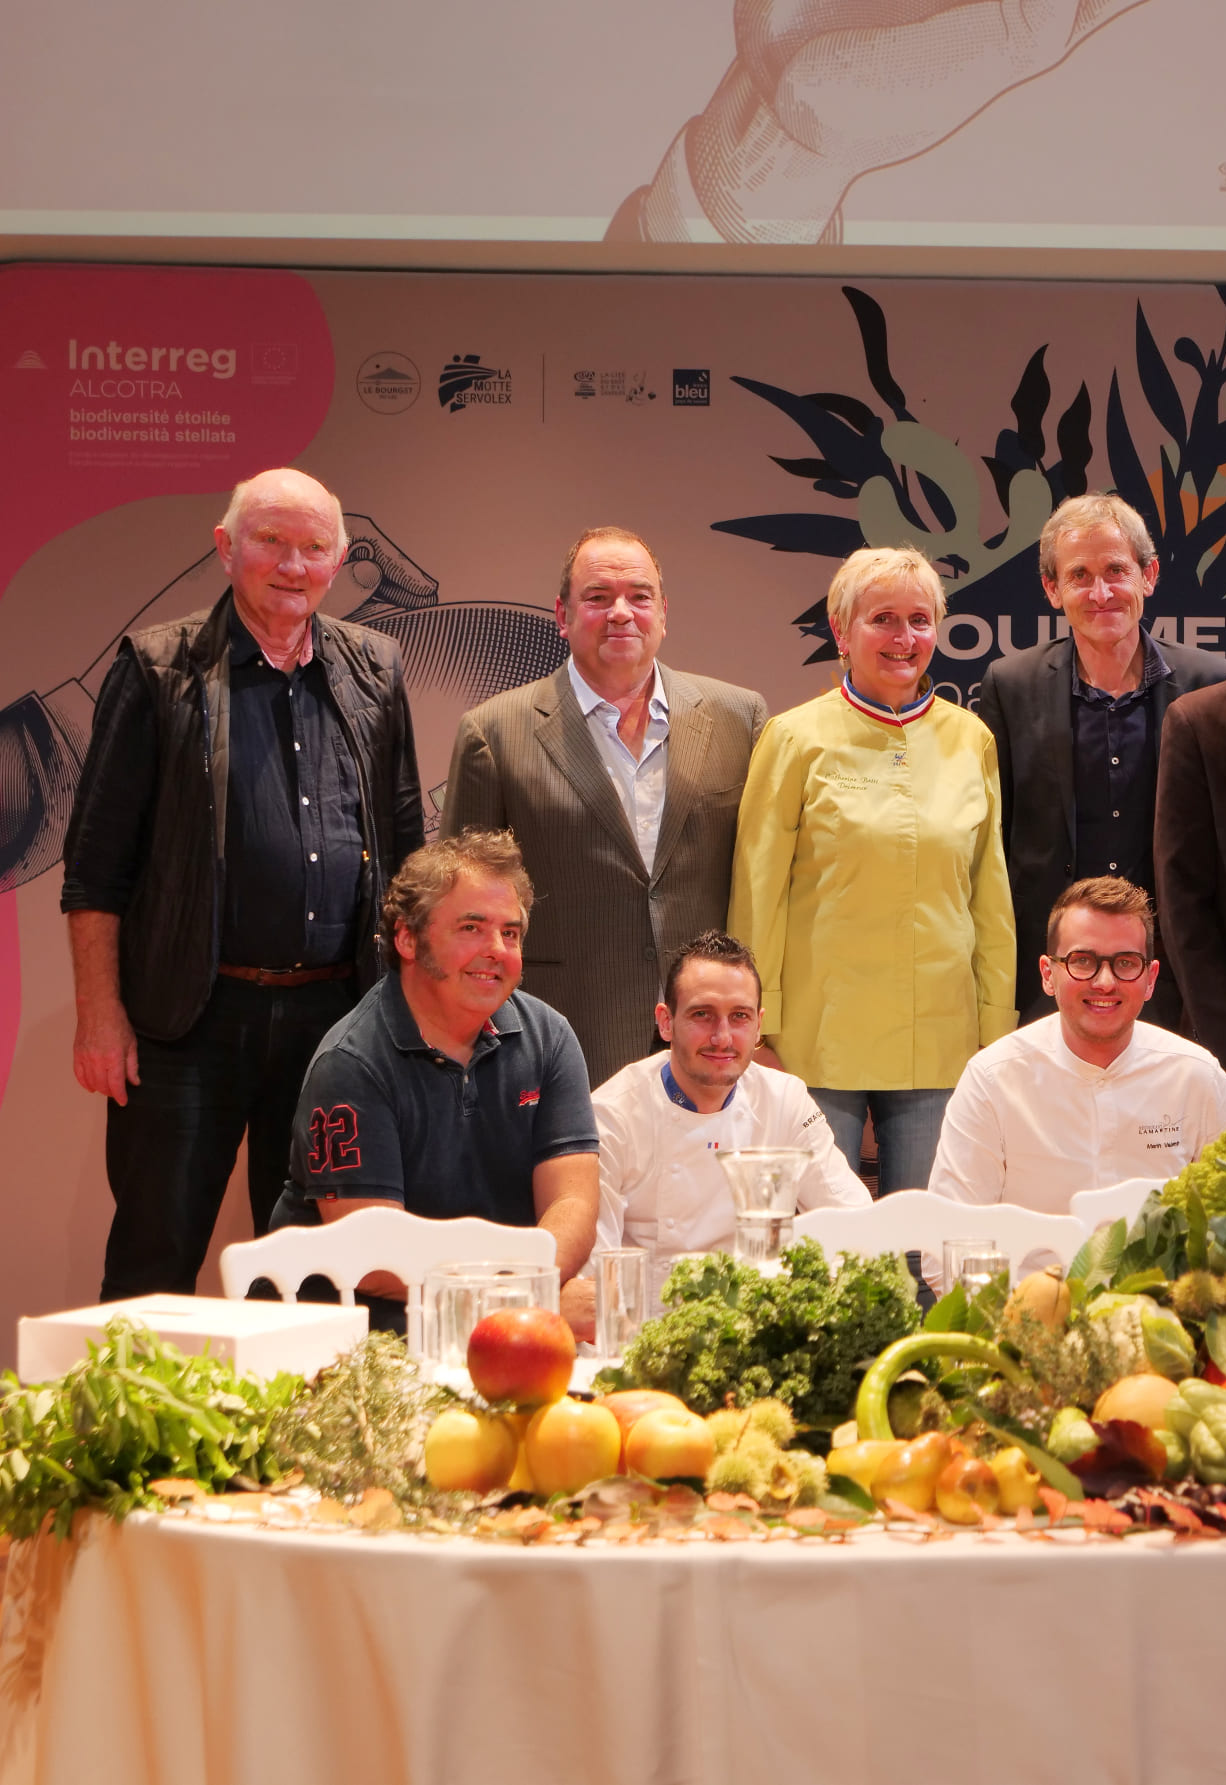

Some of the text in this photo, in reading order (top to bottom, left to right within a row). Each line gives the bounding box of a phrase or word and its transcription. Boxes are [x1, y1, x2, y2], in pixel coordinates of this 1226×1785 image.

[68, 339, 237, 379] Interreg
[498, 369, 512, 380] LA
[69, 379, 183, 399] ALCOTRA
[474, 381, 512, 392] MOTTE
[675, 384, 707, 398] bleu
[455, 393, 512, 404] SERVOLEX
[70, 409, 231, 425] biodiversité étoilée
[70, 426, 237, 443] biodiversità stellata
[308, 1104, 361, 1173] 32
